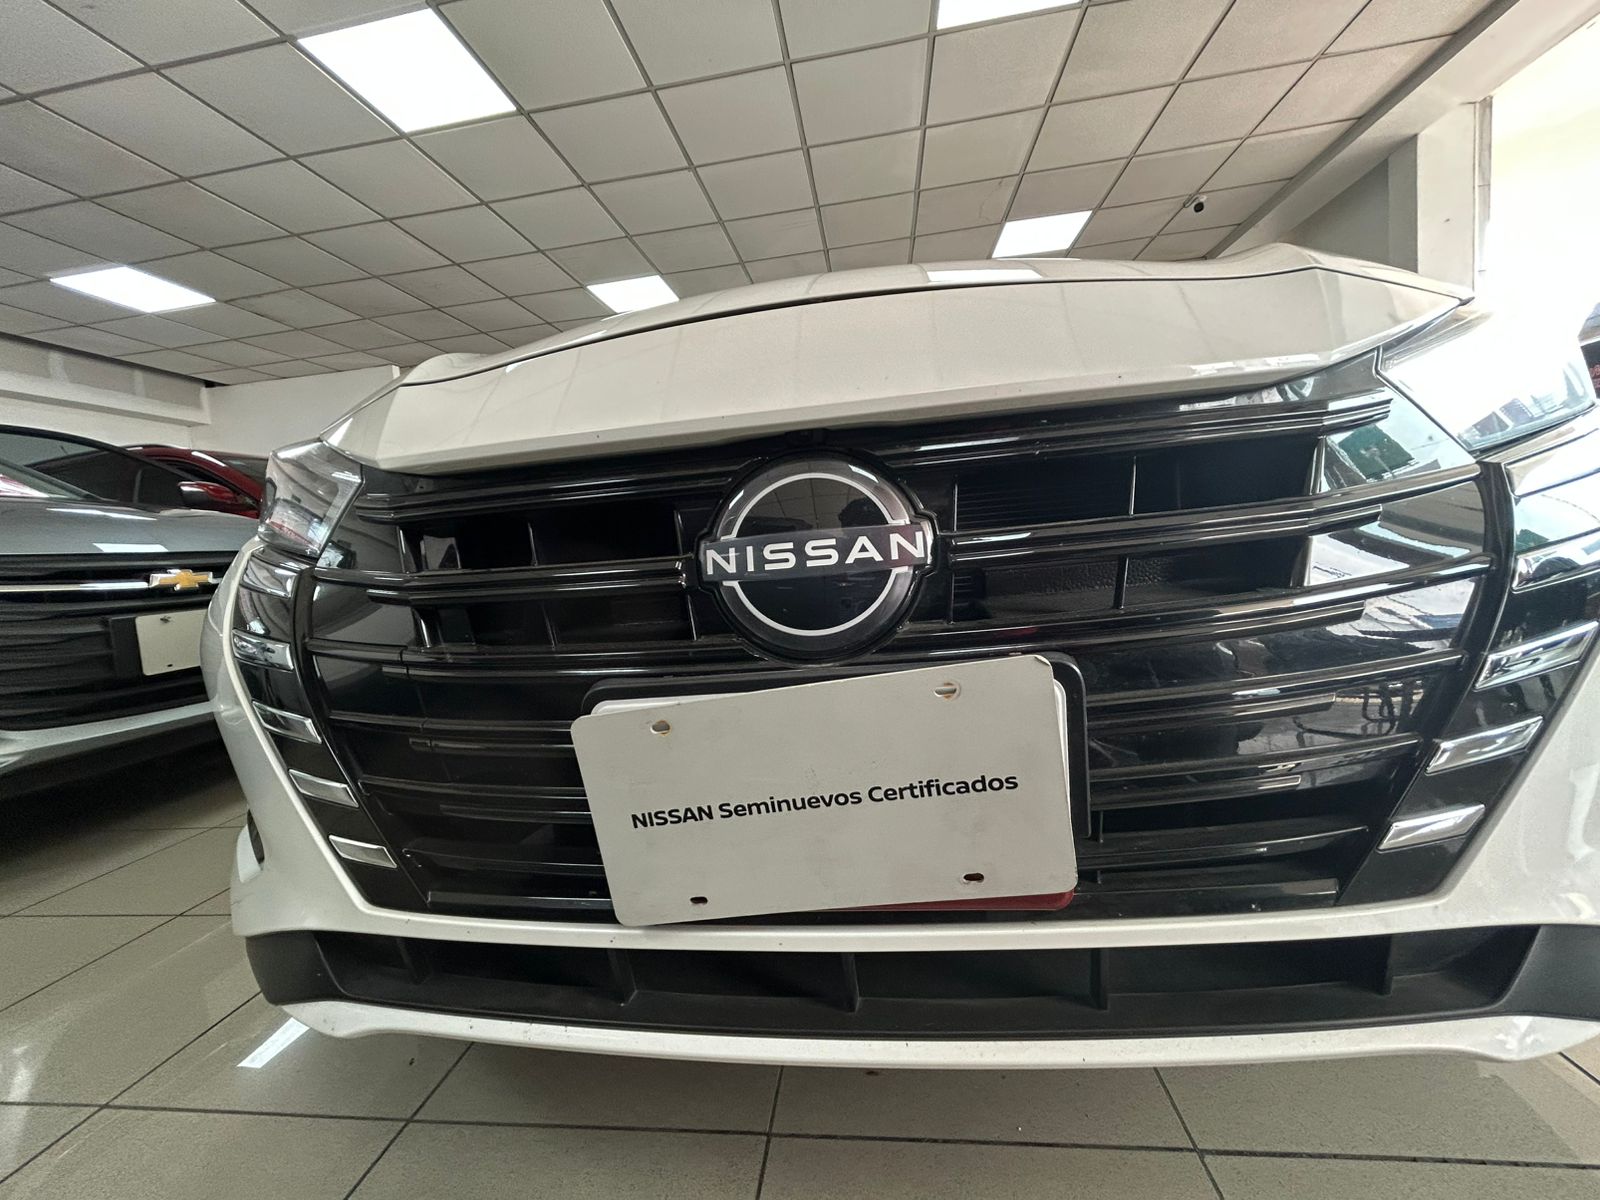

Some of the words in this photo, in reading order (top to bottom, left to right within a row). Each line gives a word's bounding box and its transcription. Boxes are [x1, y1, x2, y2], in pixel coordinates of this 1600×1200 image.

[705, 531, 926, 575] NISSAN
[631, 805, 713, 829] NISSAN
[718, 791, 863, 819] Seminuevos
[867, 774, 1019, 803] Certificados
